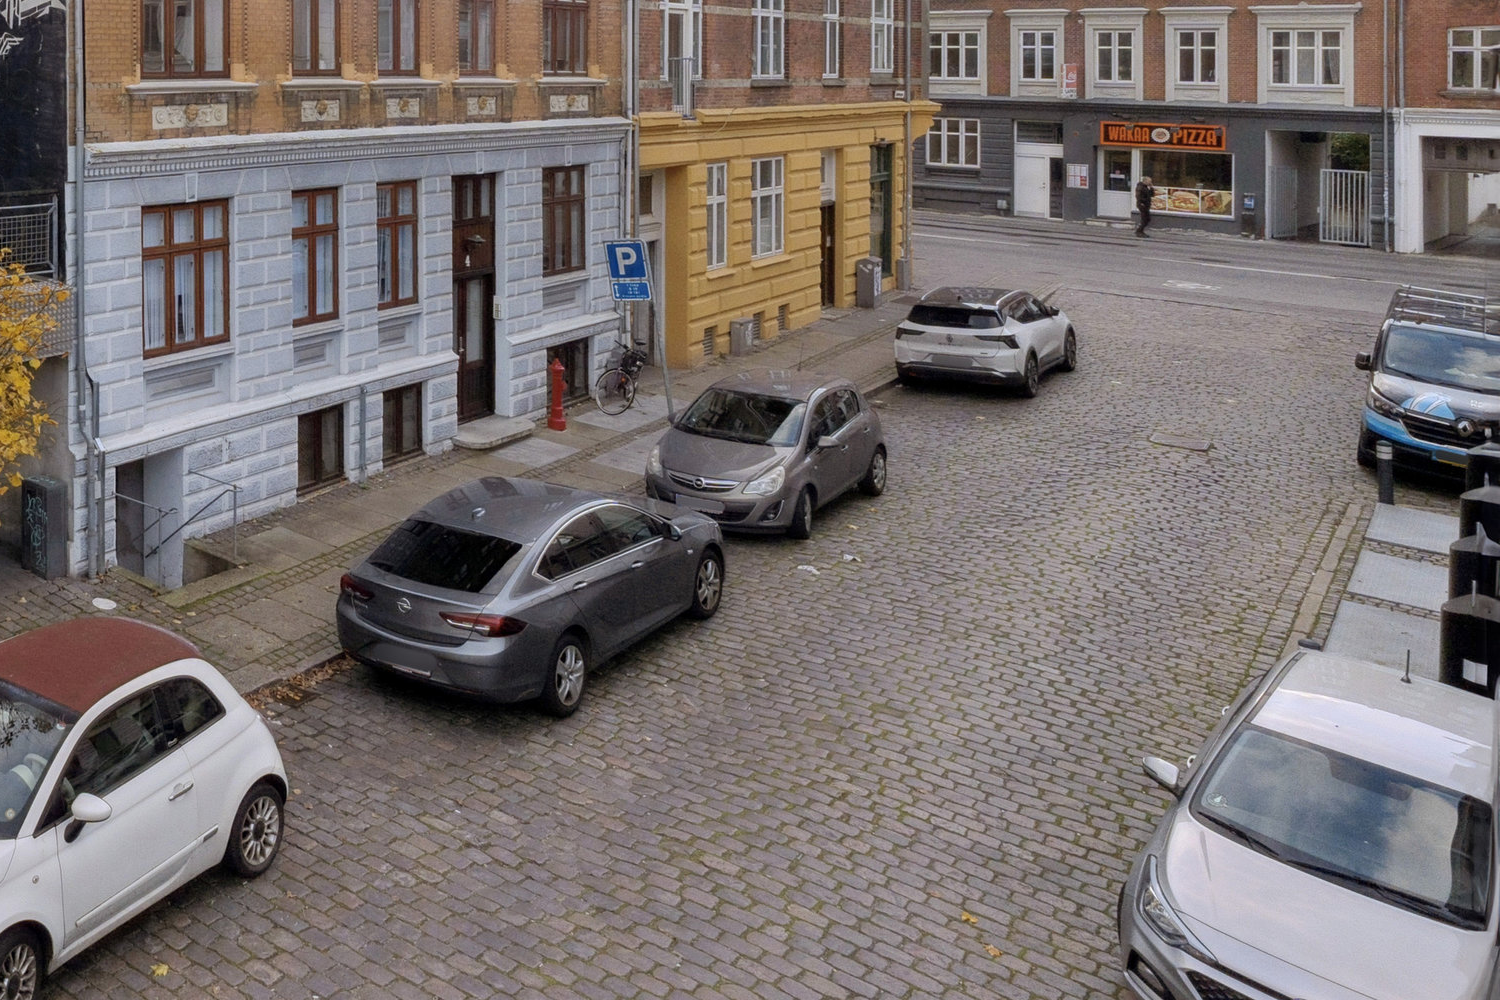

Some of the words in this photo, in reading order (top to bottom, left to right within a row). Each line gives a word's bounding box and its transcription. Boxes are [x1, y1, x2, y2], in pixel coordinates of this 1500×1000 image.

[1108, 126, 1149, 141] WAKAA
[1172, 129, 1217, 145] PIZZA
[465, 255, 470, 267] 4
[615, 247, 636, 275] P
